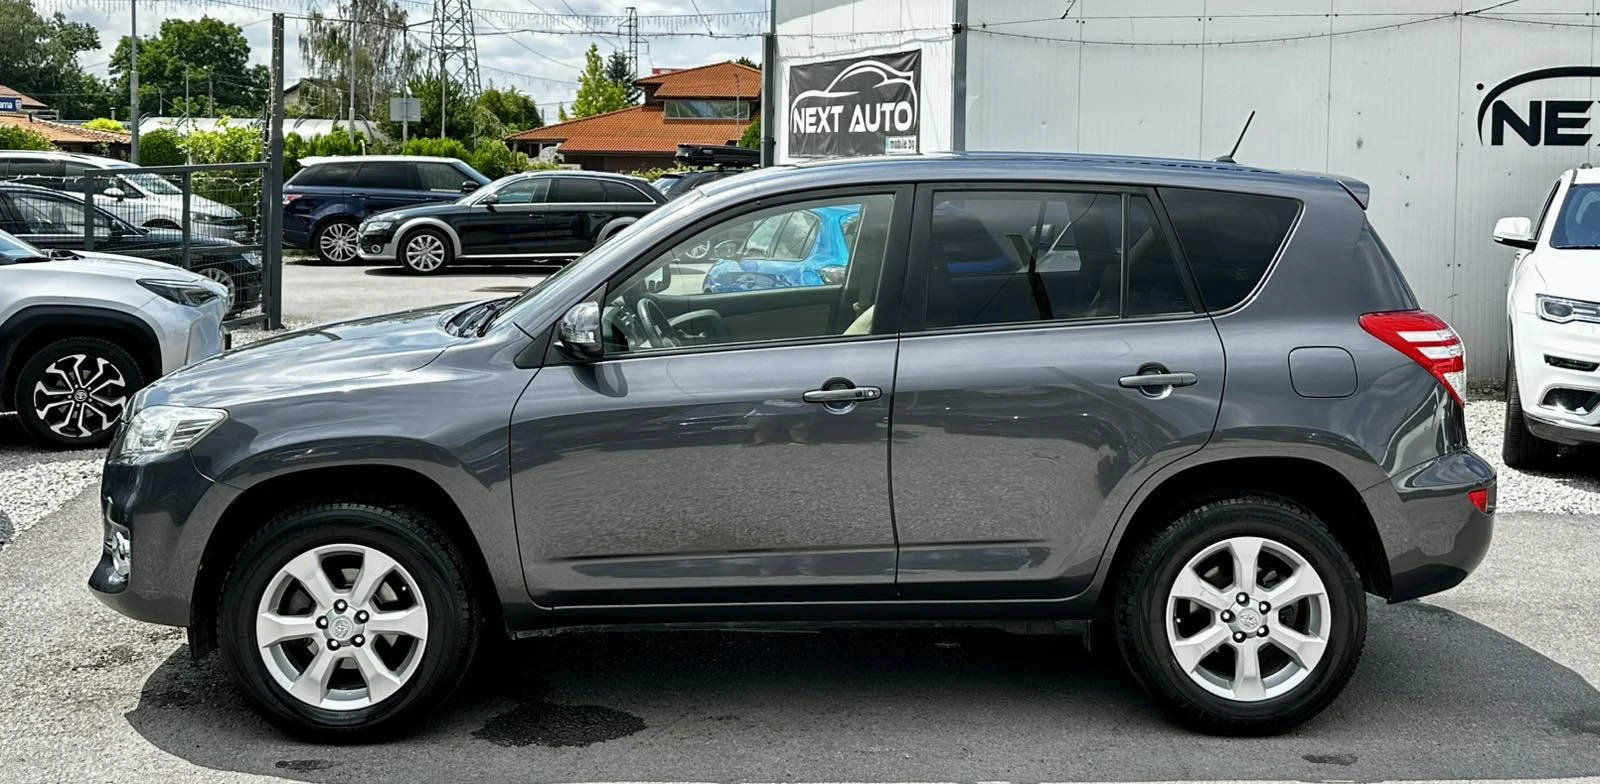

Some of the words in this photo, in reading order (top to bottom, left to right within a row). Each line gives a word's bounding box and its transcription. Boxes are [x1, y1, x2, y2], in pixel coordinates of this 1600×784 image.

[793, 105, 844, 134] NEXT
[848, 101, 913, 133] AUTO
[1491, 100, 1600, 147] NE
